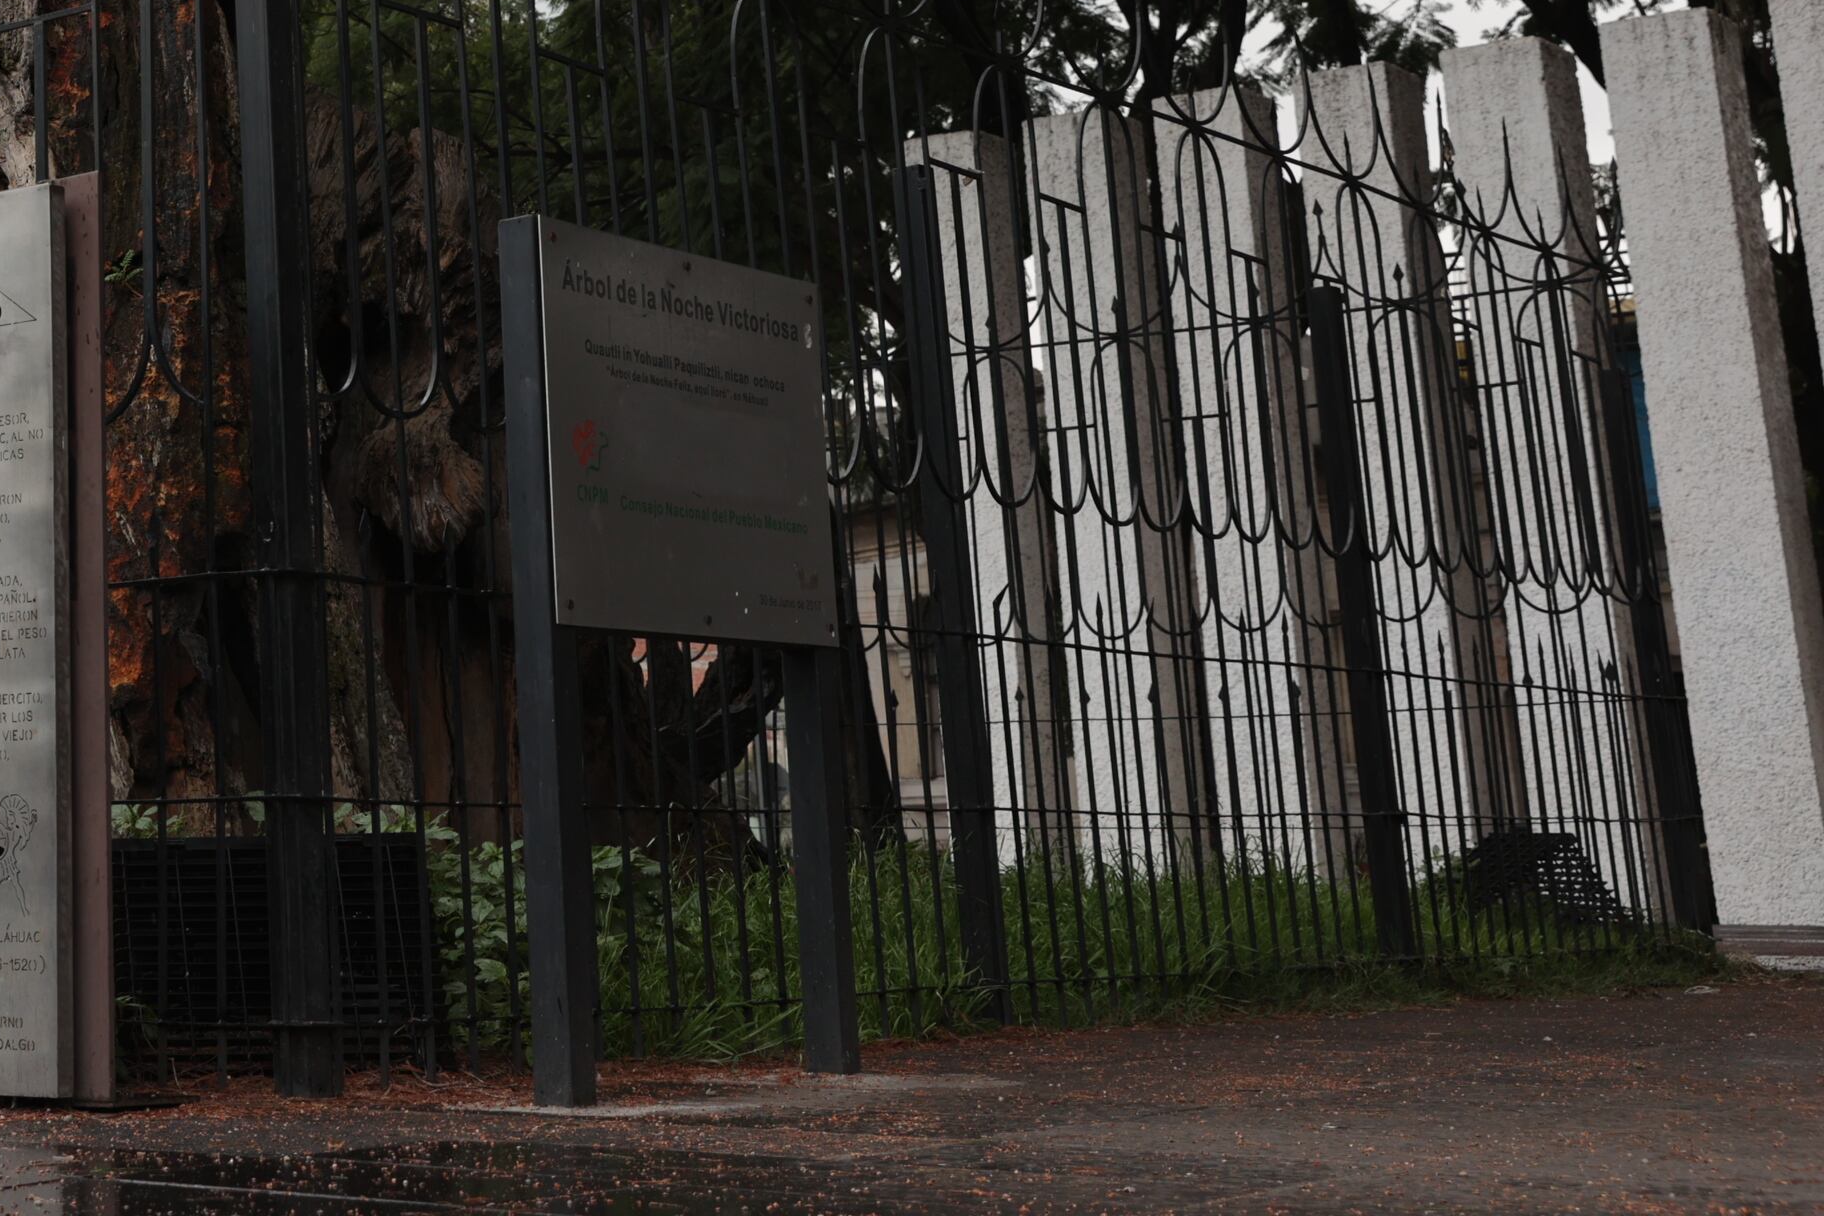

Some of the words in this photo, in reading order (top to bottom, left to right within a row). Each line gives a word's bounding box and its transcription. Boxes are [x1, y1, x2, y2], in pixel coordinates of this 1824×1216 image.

[559, 256, 612, 302] Árbol
[614, 275, 637, 307] de
[640, 281, 658, 312] la
[658, 285, 715, 324] Noche
[715, 298, 800, 343] Victoriosa
[10, 429, 24, 444] AL
[27, 426, 44, 441] NO
[575, 482, 610, 506] CNPM
